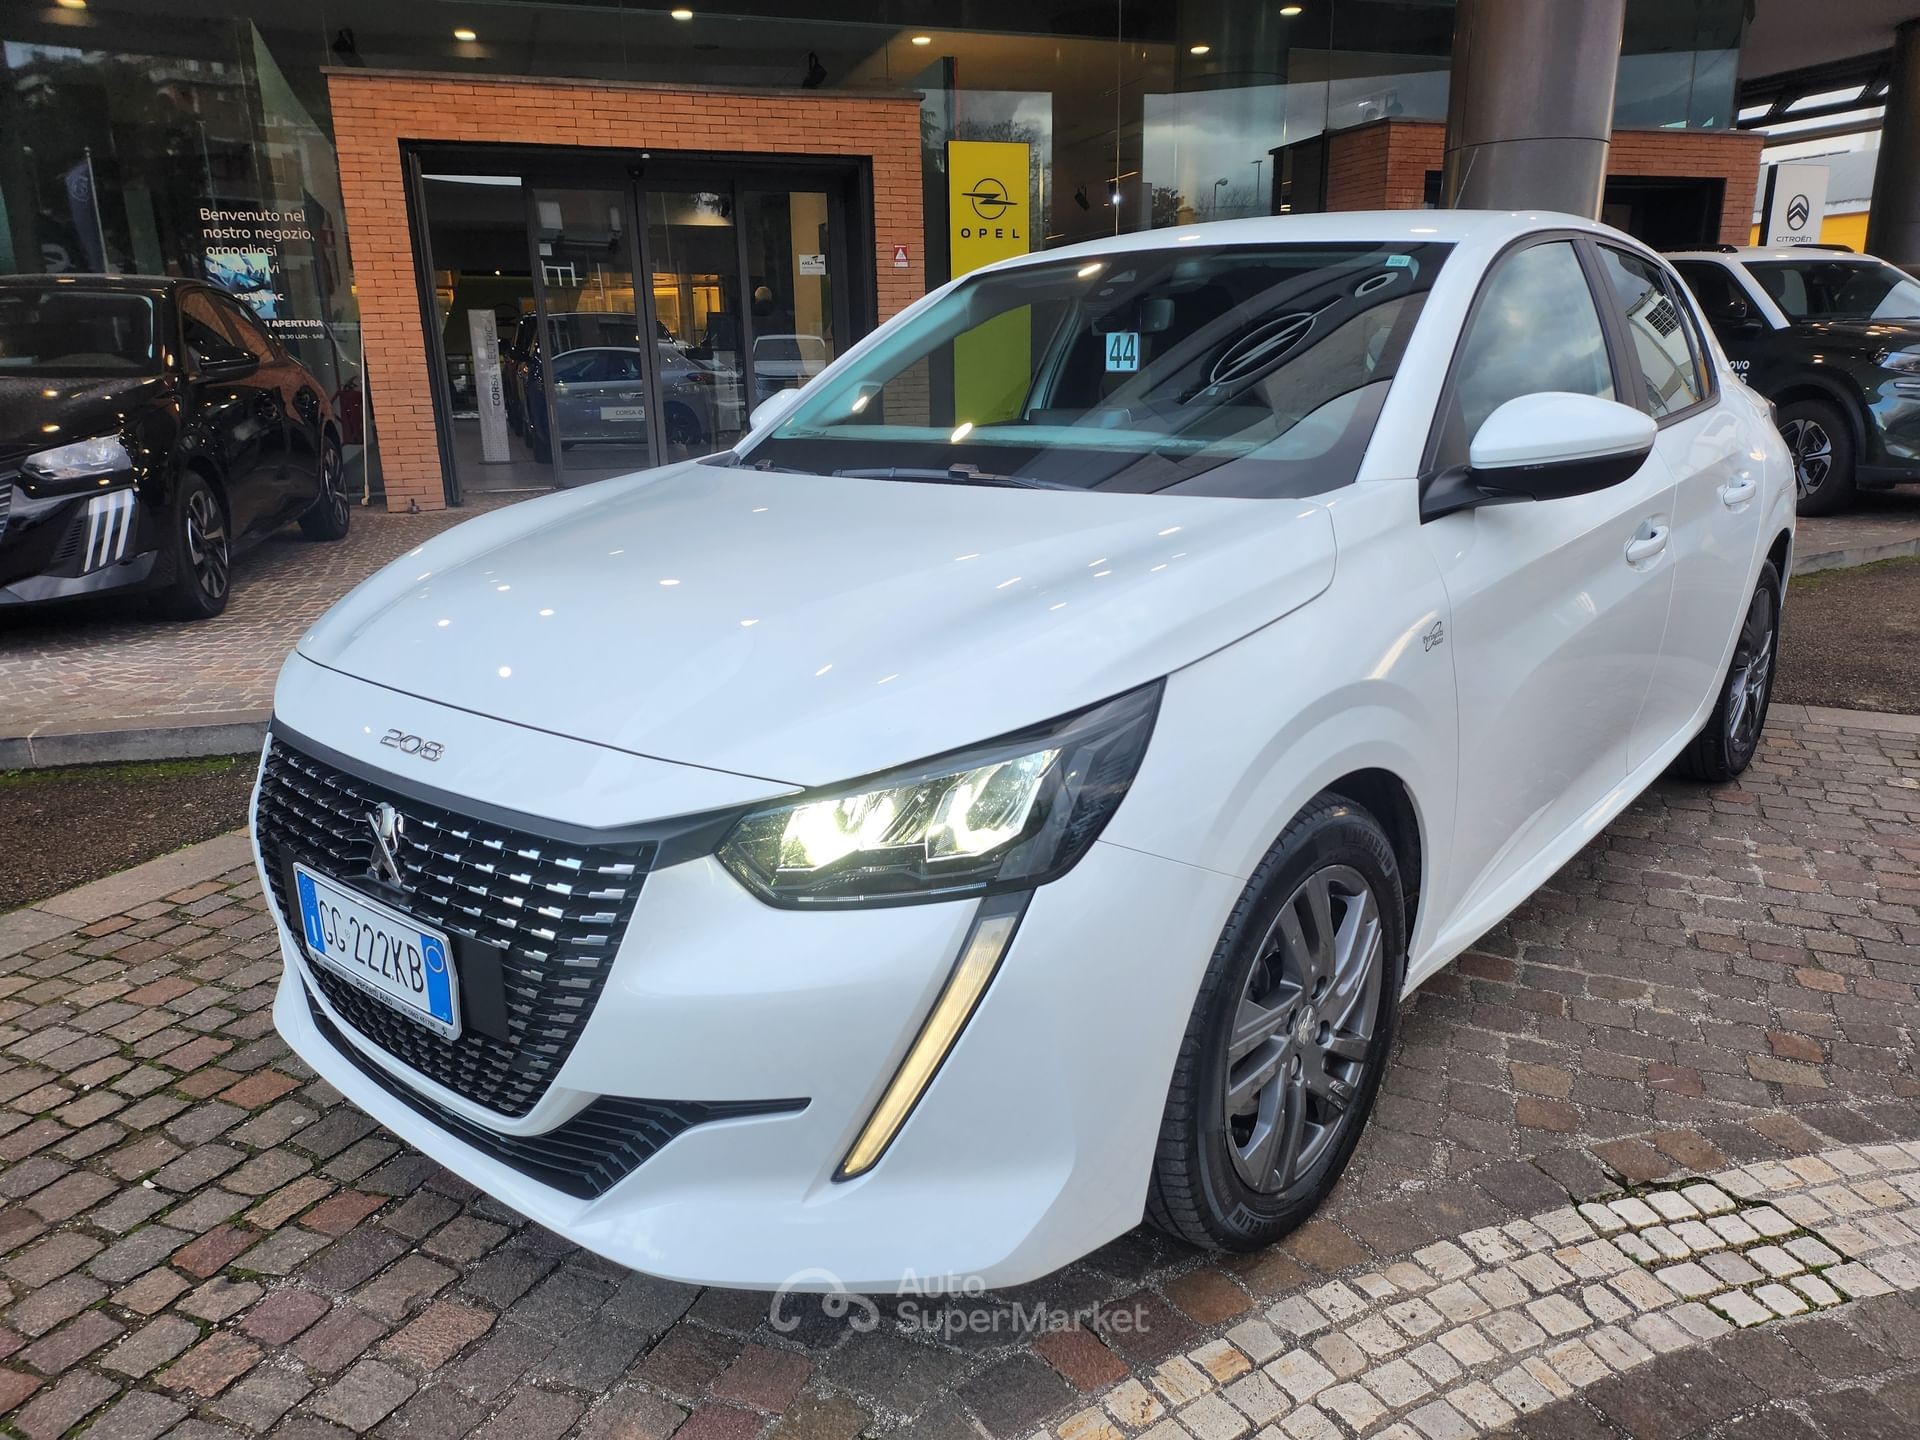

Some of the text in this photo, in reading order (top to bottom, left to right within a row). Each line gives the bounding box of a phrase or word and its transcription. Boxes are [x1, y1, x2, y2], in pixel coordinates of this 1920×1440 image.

[200, 207, 305, 222] Benvenuto nel
[203, 226, 315, 243] nostro negozio,
[961, 227, 1020, 239] OPEL
[272, 320, 324, 328] APERTURA
[1110, 335, 1136, 368] 44
[490, 374, 501, 407] CORSA
[379, 728, 445, 762] 208
